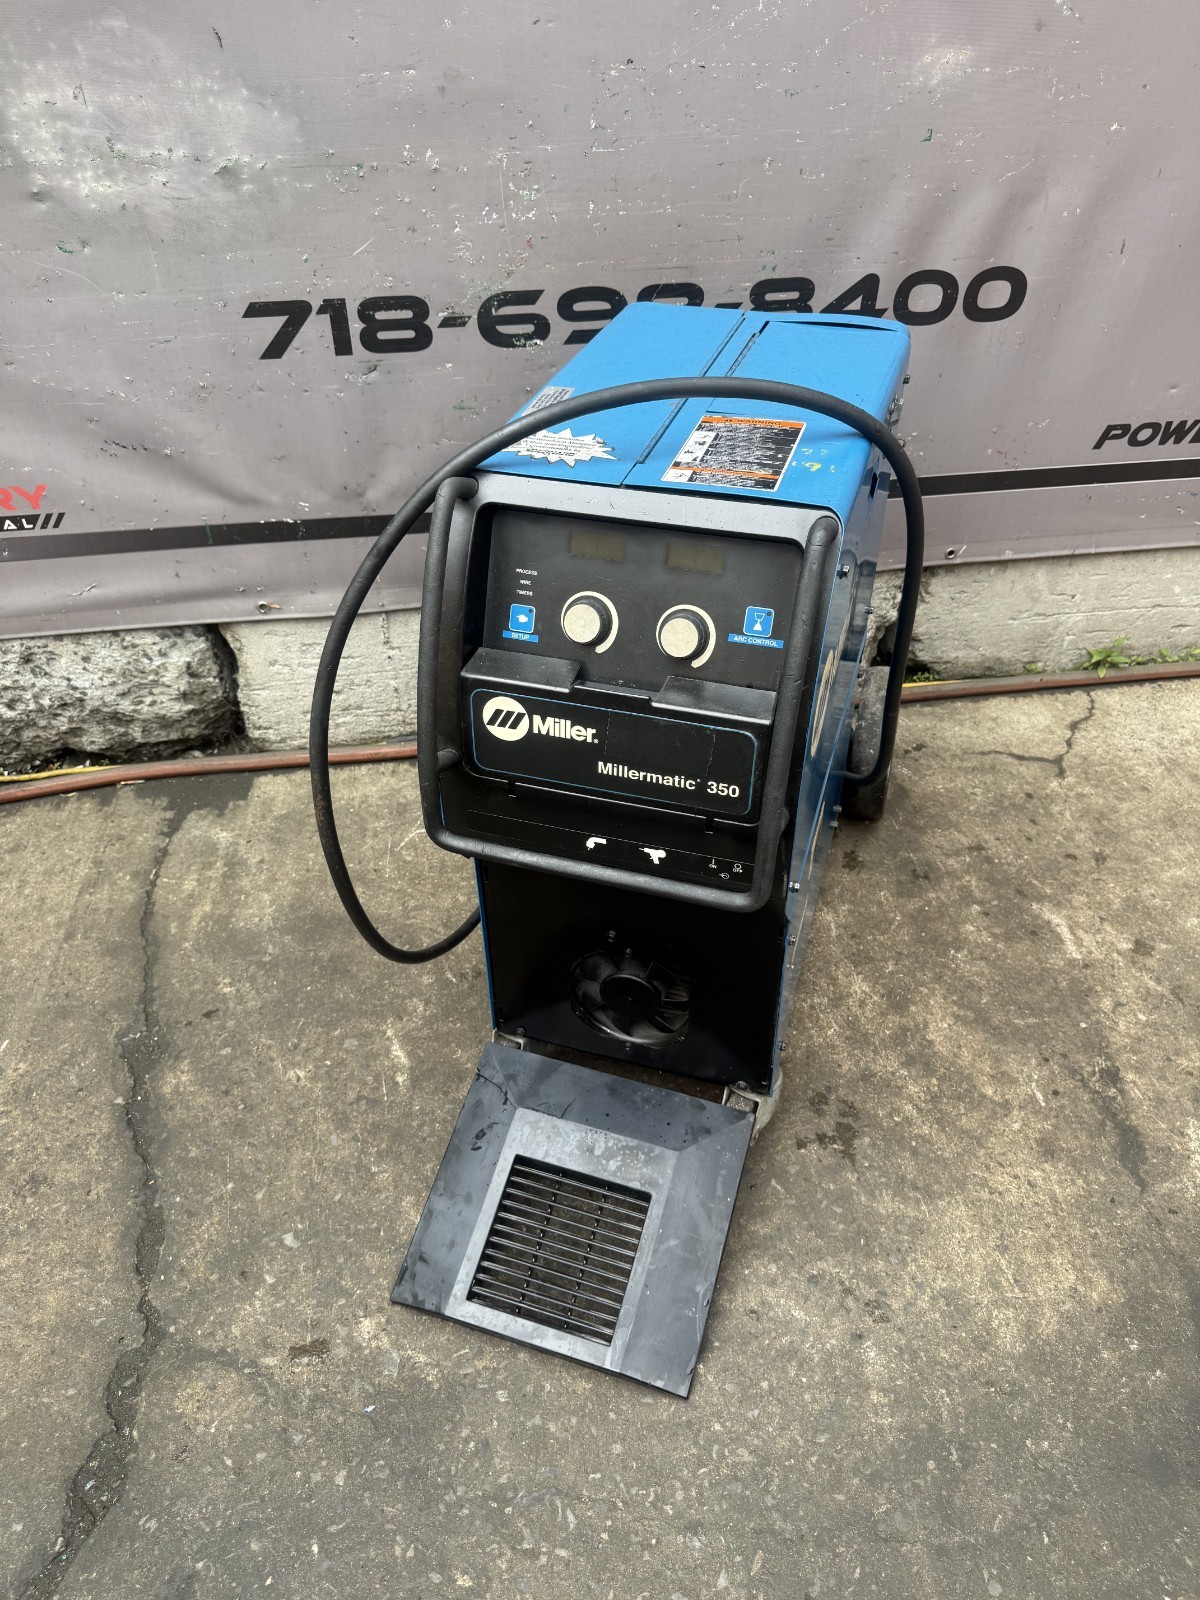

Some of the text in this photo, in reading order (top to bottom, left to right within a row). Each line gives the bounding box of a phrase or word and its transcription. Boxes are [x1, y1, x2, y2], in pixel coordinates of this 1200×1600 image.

[515, 568, 538, 576] PROCESS
[511, 632, 530, 641] SETUP
[733, 635, 779, 648] ARC CONTROL
[706, 781, 740, 798] 350
